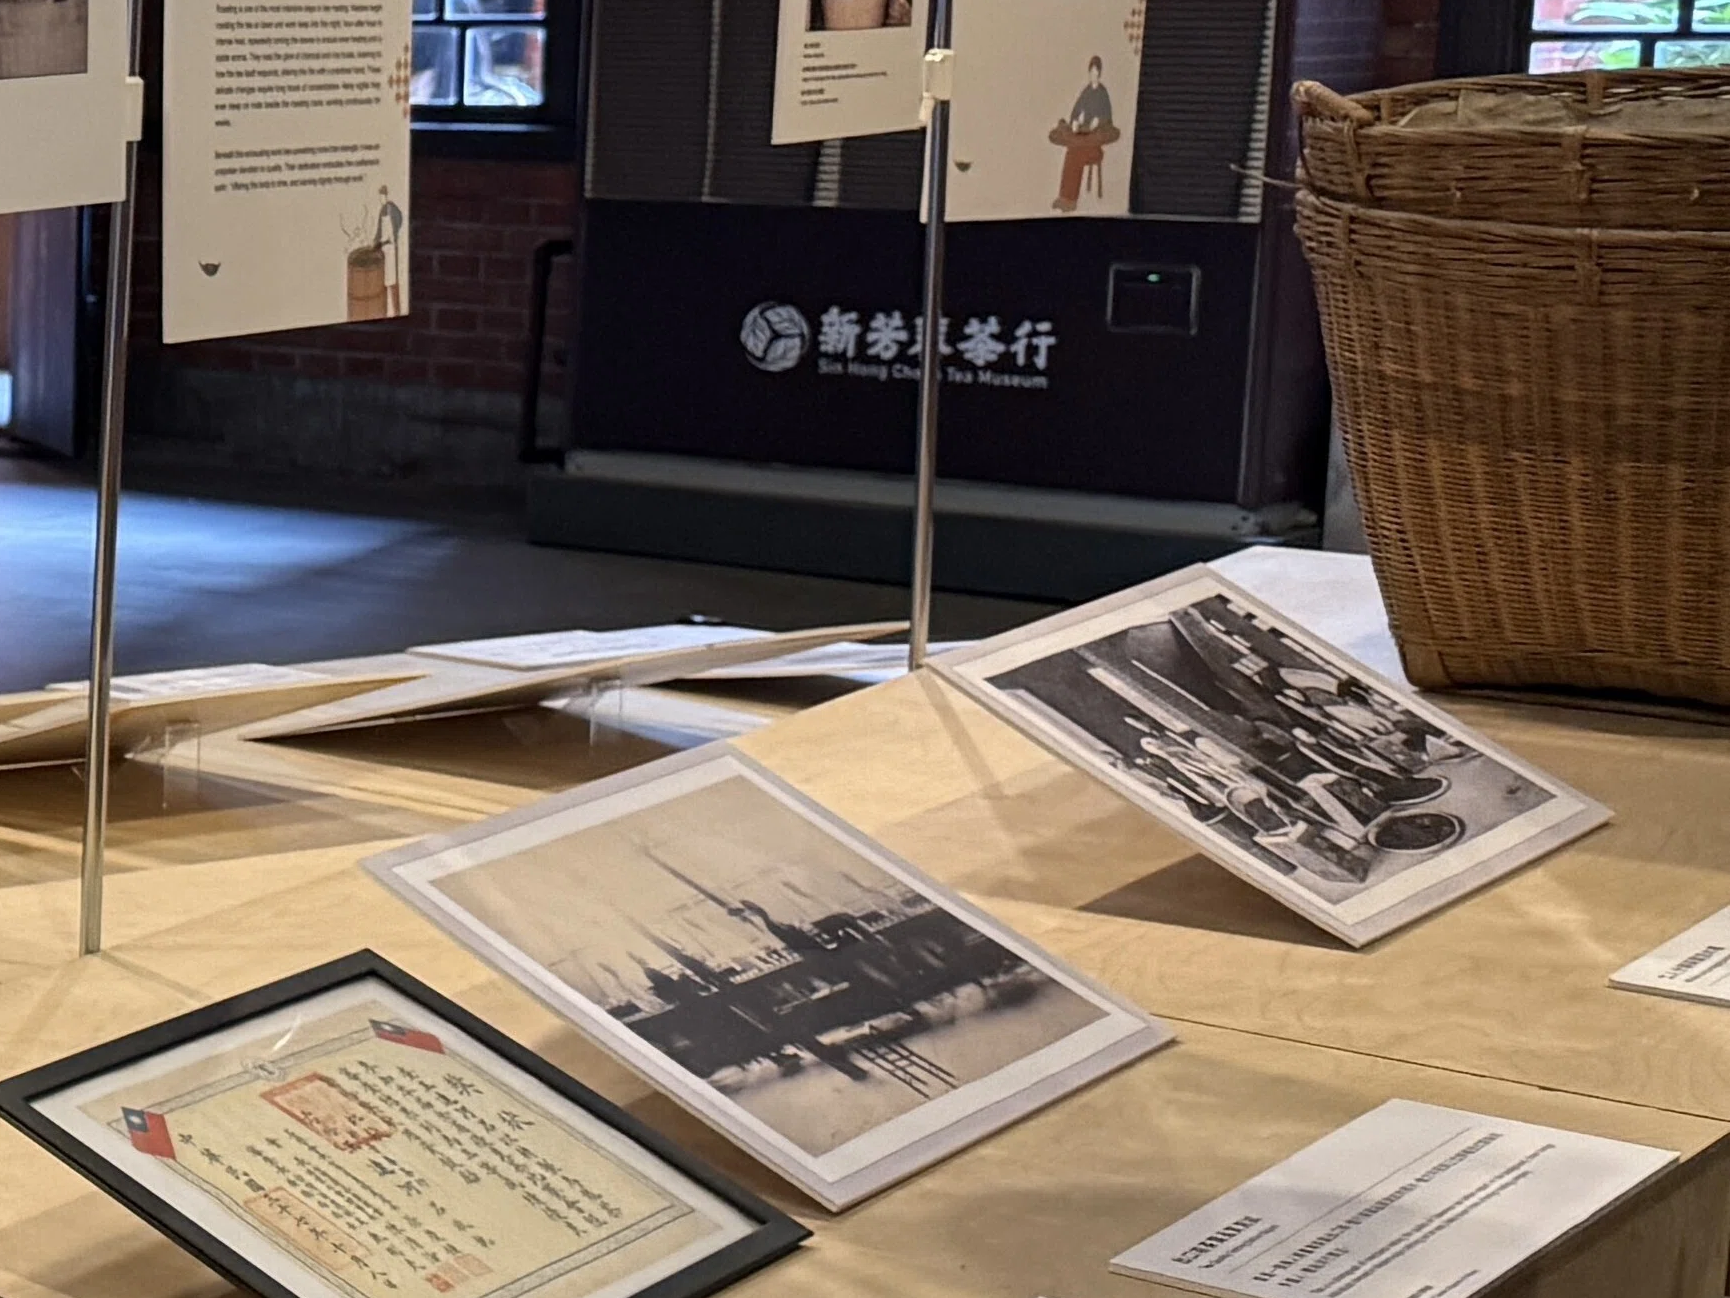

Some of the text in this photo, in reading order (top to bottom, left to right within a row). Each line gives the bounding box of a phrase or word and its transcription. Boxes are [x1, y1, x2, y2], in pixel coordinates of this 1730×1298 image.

[847, 360, 888, 382] Hong
[946, 365, 974, 385] Tea
[976, 368, 1050, 391] Museum
